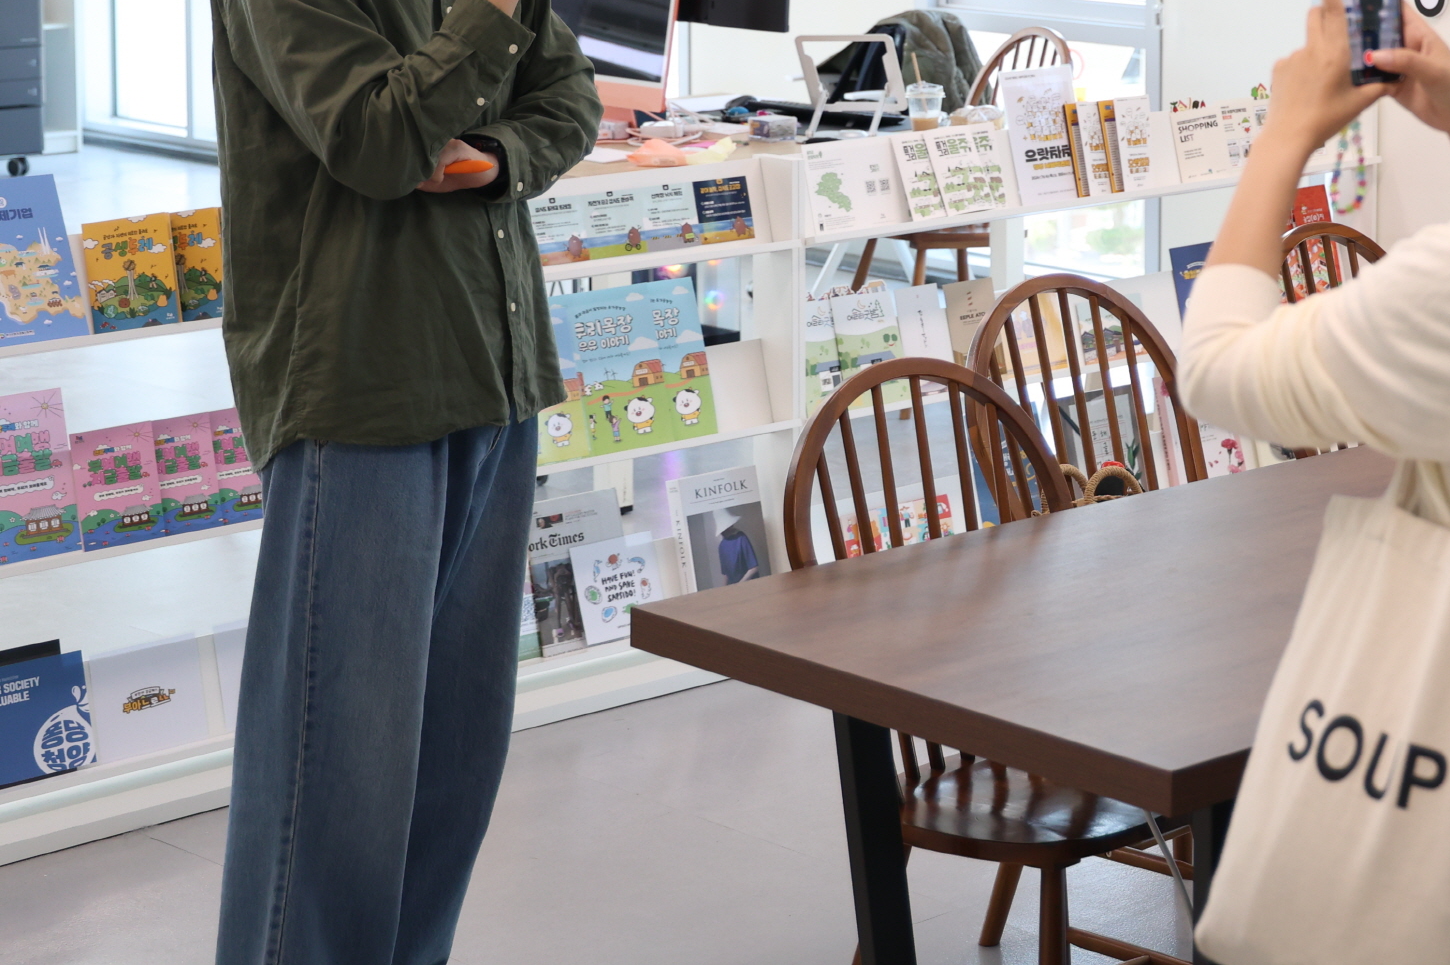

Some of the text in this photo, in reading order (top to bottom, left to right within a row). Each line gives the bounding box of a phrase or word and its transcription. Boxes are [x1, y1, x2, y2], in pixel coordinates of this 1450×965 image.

[1178, 120, 1218, 134] SHOPPING
[1180, 134, 1194, 143] LIST
[651, 308, 680, 328] 목장
[578, 335, 630, 352] 우유 이야기
[0, 431, 51, 455] 여여행
[0, 449, 52, 477] 금출발
[694, 479, 748, 499] KINFOLK
[528, 532, 585, 552] ork Times
[601, 569, 635, 585] HAVE FUN!
[3, 676, 40, 694] SOCIETY
[1287, 698, 1448, 810] SOUP
